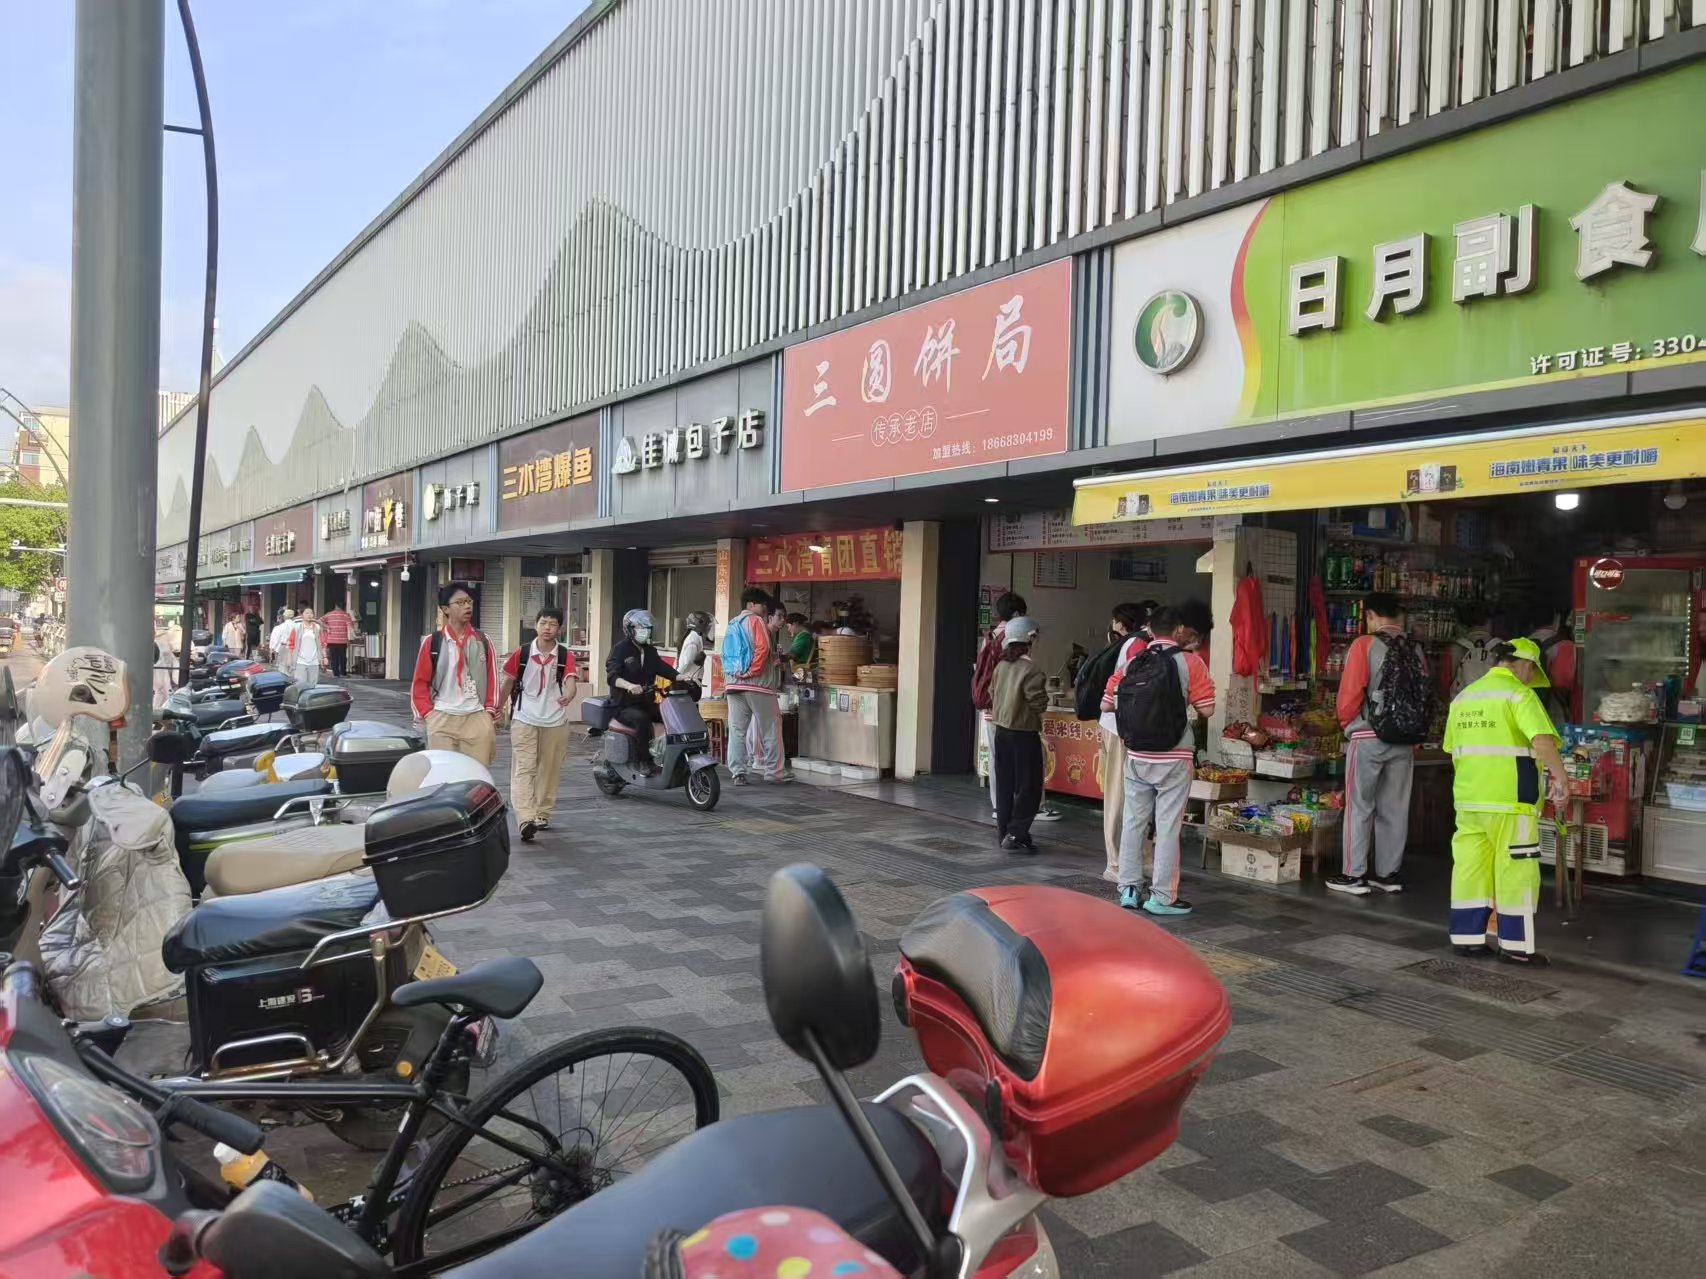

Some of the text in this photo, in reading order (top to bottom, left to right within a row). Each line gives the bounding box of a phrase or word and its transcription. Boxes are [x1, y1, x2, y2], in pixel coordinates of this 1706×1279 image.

[1289, 169, 1706, 337] 日月副食
[872, 408, 936, 443] 传承老店
[983, 428, 1053, 451] 18668304199
[502, 447, 593, 500] 三水湾爆鱼
[1490, 447, 1659, 477] 海南嫩青果 味美更耐嚼
